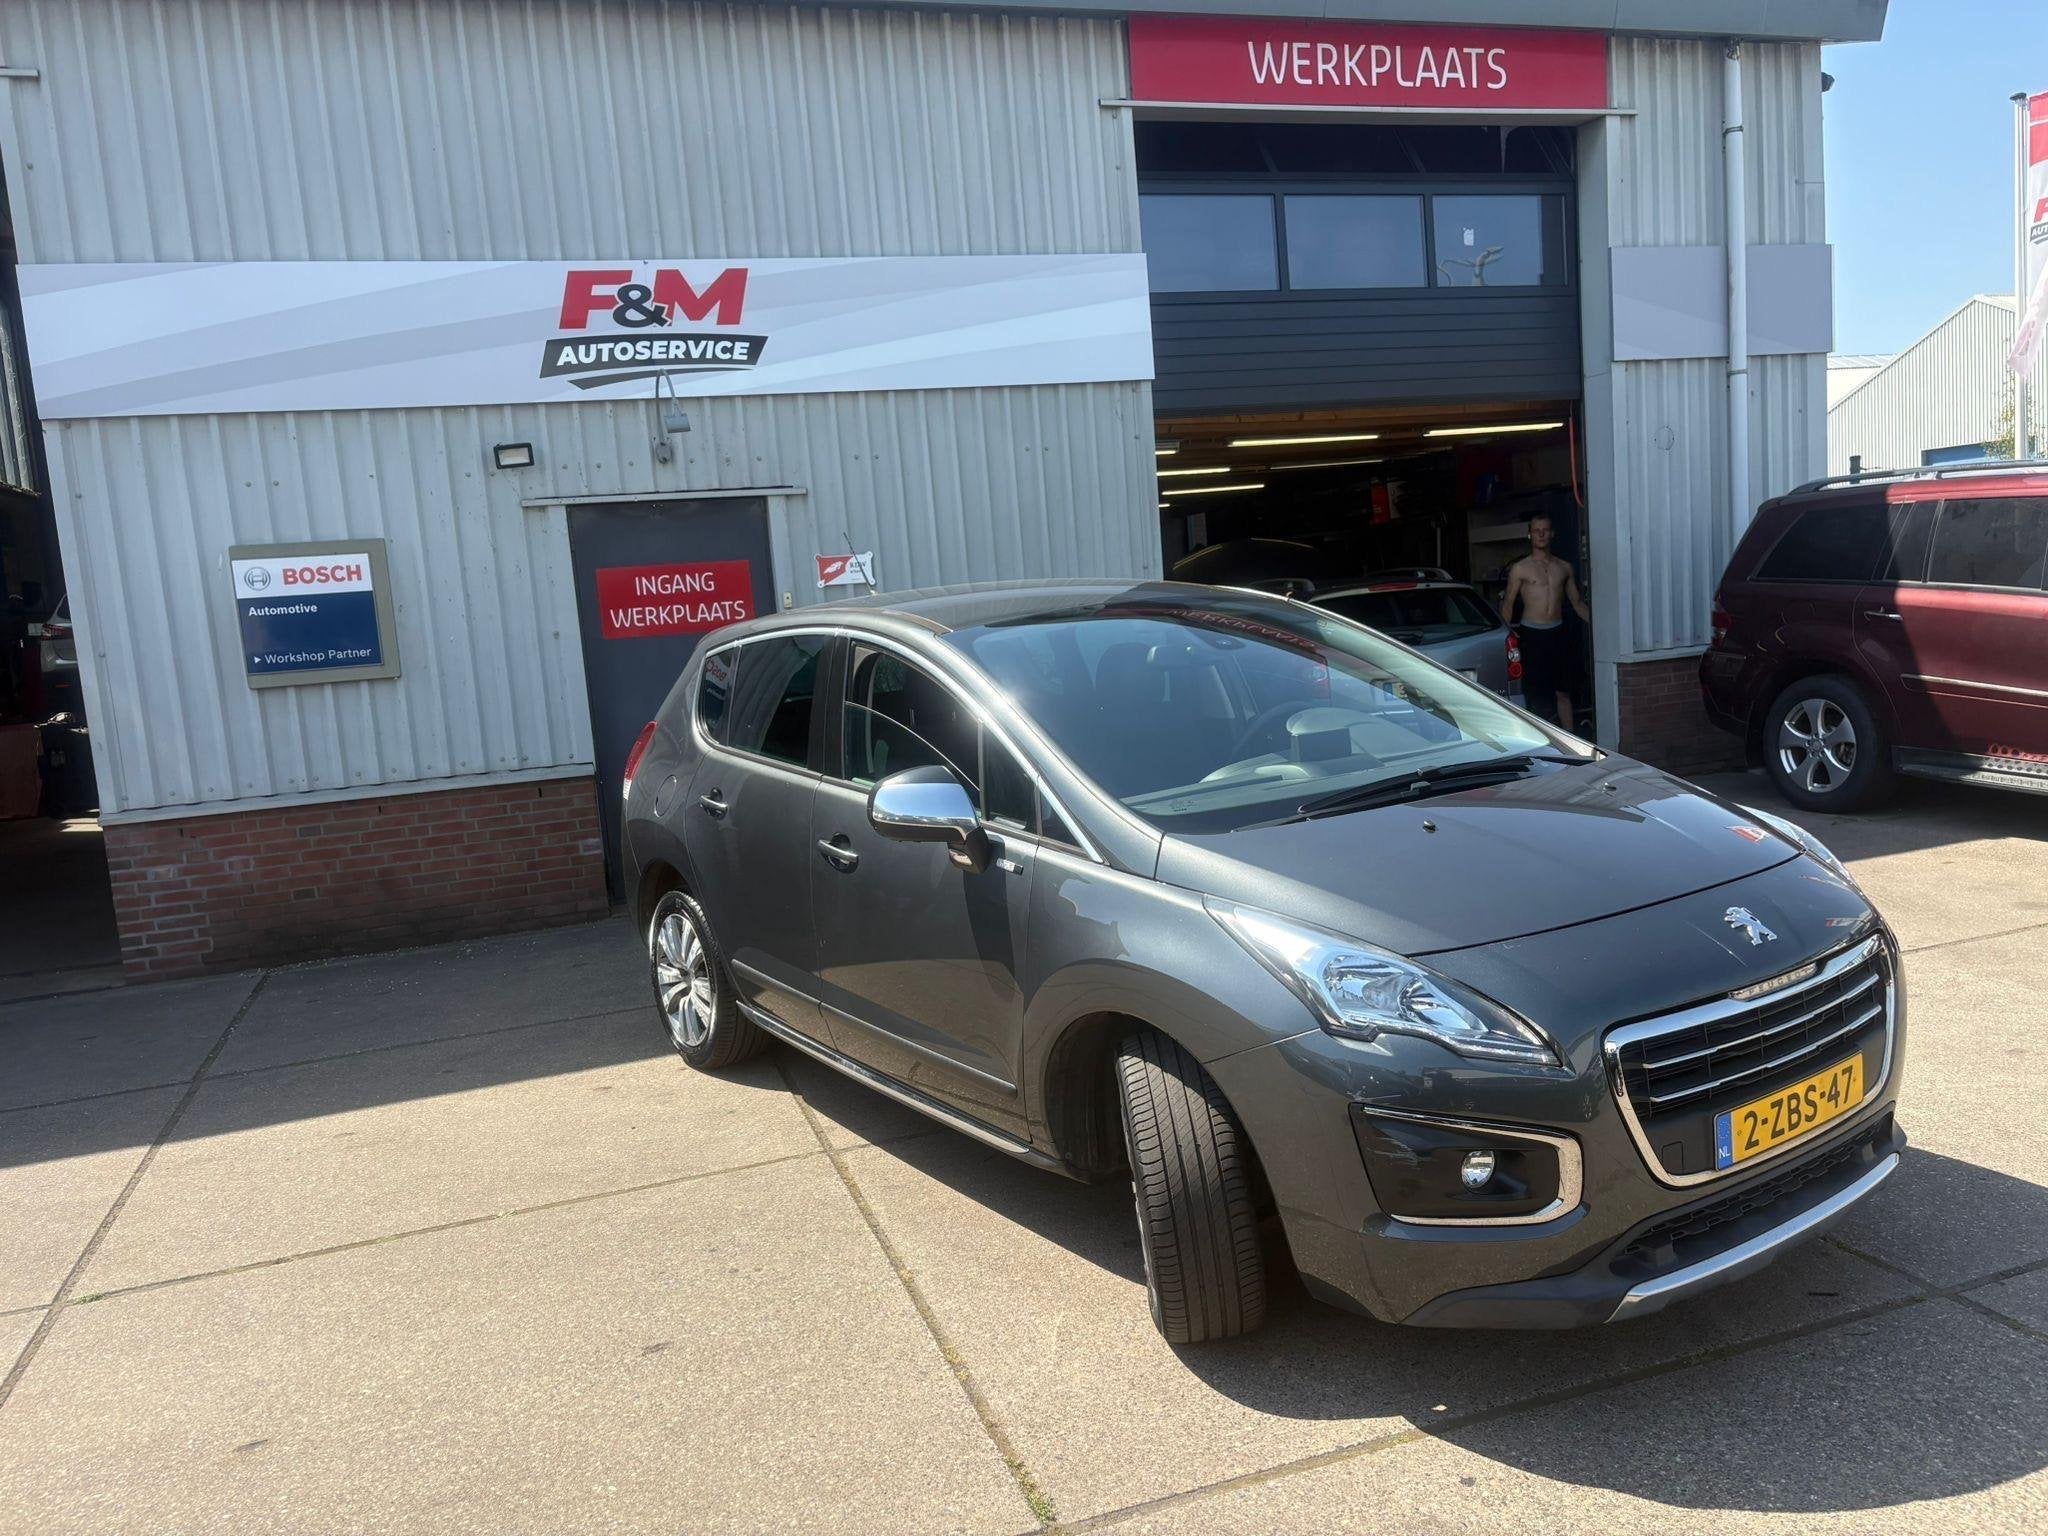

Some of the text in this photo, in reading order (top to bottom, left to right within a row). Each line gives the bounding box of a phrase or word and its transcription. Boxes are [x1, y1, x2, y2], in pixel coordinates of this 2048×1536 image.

[1247, 40, 1507, 90] WERKPLAATS
[559, 267, 748, 330] F&M
[556, 339, 750, 366] AUTOSERVICE
[282, 564, 363, 586] BOSCH
[635, 572, 715, 596] INGANG
[248, 603, 318, 617] Automotive
[610, 600, 746, 629] WERKPLAATS
[264, 647, 372, 665] Workshop Partner
[1748, 967, 1810, 996] PEUGEOT
[1743, 1065, 1853, 1151] 2-ZBS-47
[1718, 1146, 1731, 1159] NL
